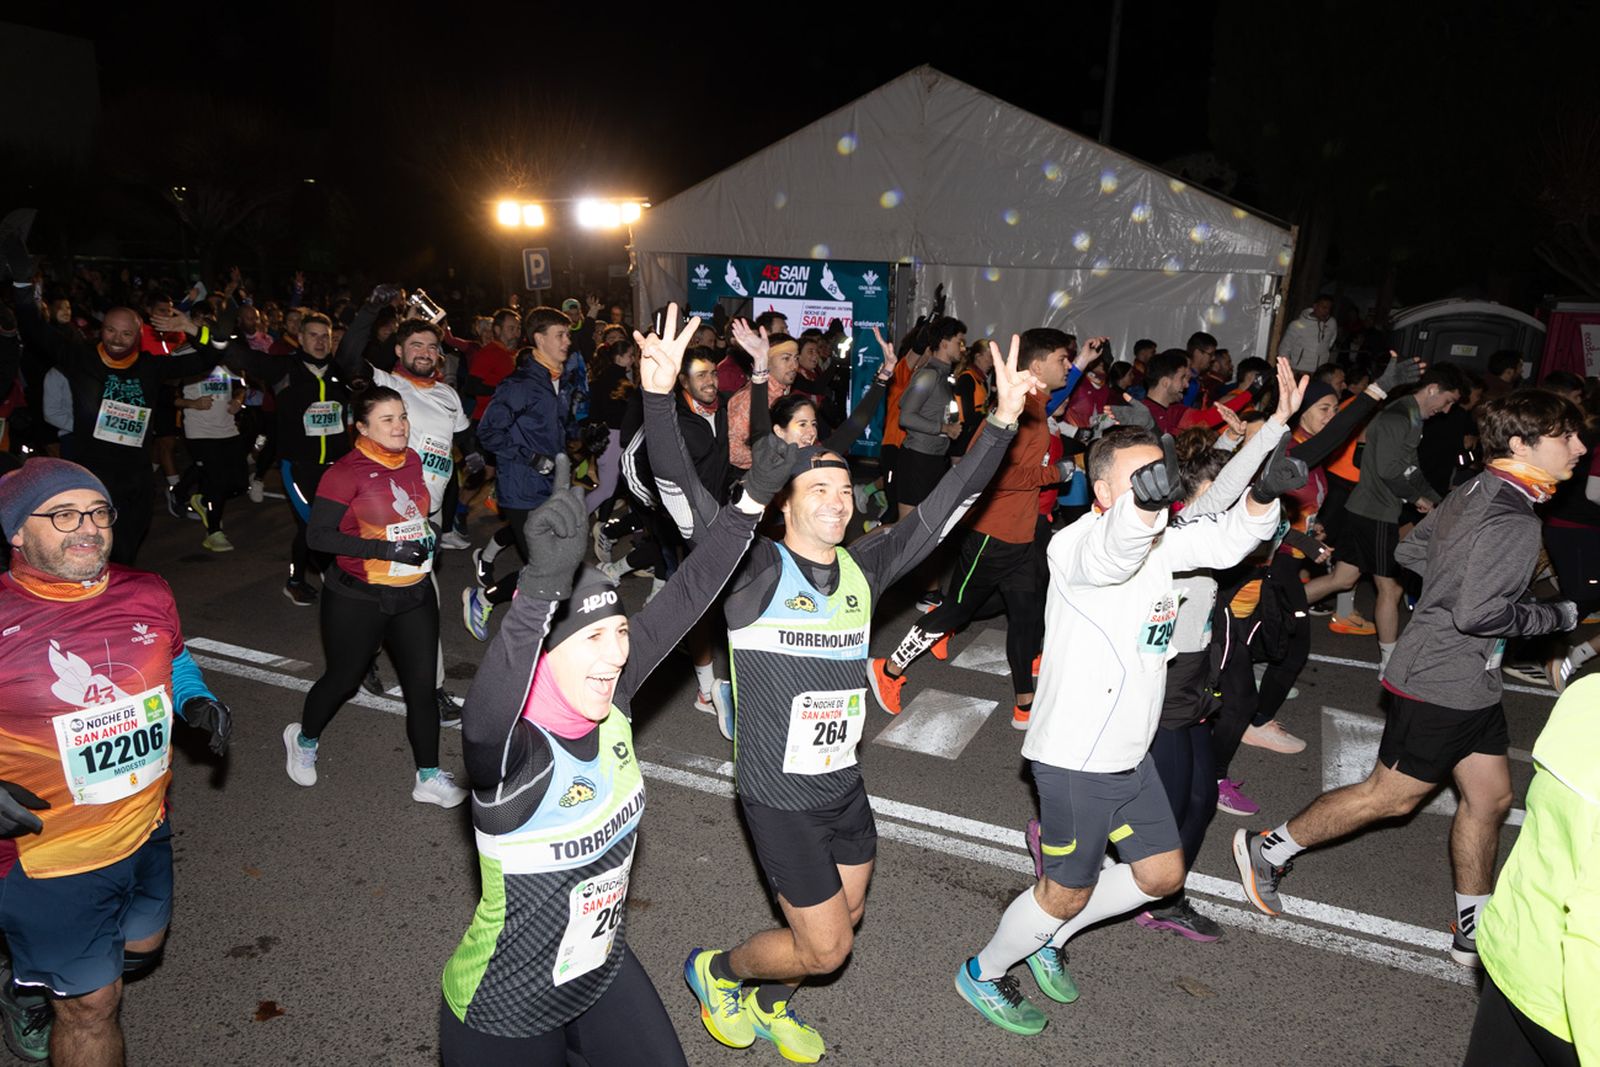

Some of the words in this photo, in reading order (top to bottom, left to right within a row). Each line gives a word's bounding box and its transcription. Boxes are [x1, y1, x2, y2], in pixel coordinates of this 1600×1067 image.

[762, 264, 780, 281] 43
[779, 265, 810, 281] SAN
[757, 278, 808, 297] ANTÓN
[802, 315, 826, 327] SAN
[105, 414, 143, 434] 12565
[309, 412, 338, 425] 12791
[405, 505, 417, 517] 43
[778, 630, 864, 648] TORREMOLINOS
[83, 683, 116, 705] 43
[812, 700, 835, 709] NOCHE
[836, 700, 844, 708] DE
[86, 711, 121, 730] NOCHE
[123, 707, 136, 719] DE
[801, 711, 819, 720] SAN
[74, 730, 99, 746] SAN
[812, 720, 848, 746] 264
[79, 723, 163, 774] 12206
[113, 759, 146, 776] MODESTO
[582, 896, 603, 915] SAN
